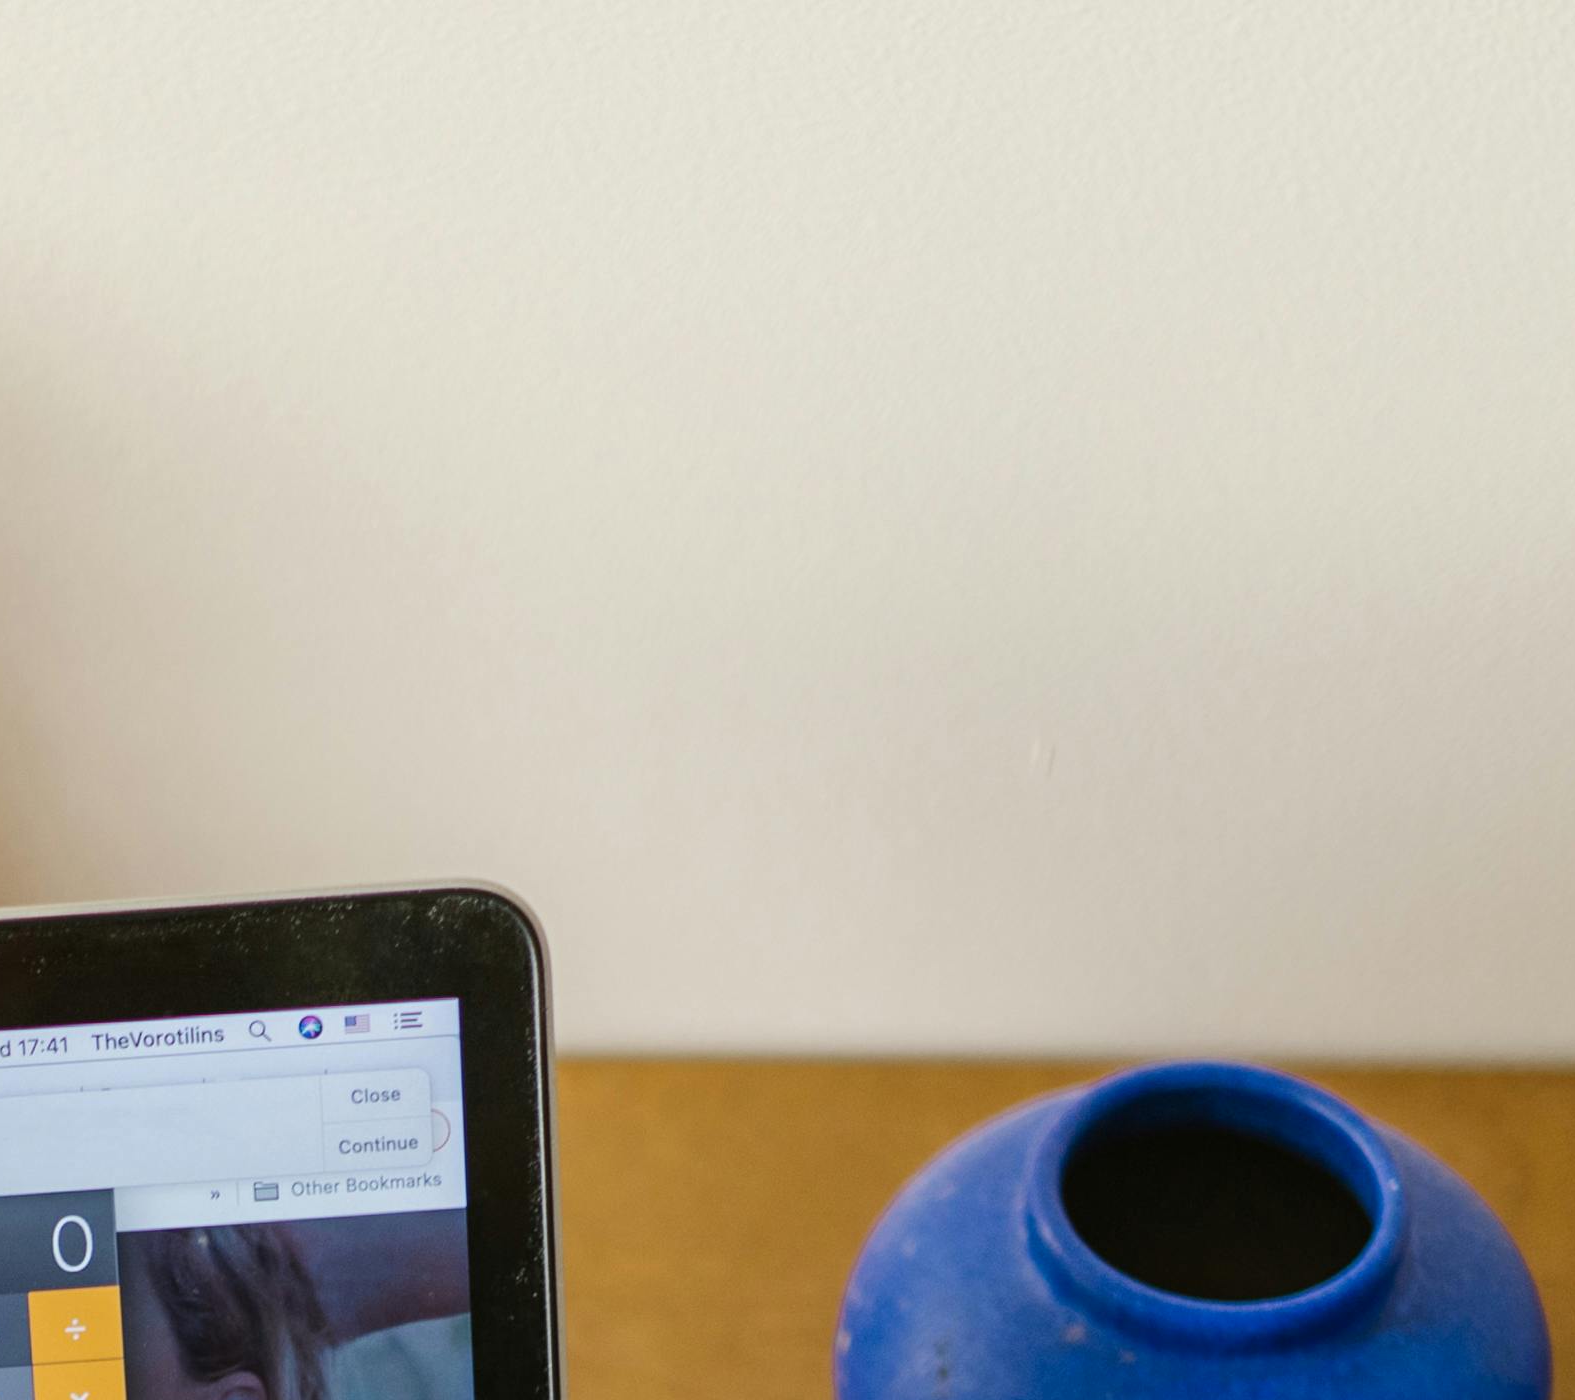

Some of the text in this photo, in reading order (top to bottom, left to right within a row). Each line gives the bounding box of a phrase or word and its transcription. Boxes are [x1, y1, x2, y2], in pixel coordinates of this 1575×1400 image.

[18, 1036, 68, 1056] 17:41
[91, 1026, 225, 1051] TheVorotilins
[350, 1088, 401, 1105] Close
[338, 1137, 419, 1155] Continue
[290, 1172, 443, 1197] Other Bookmarks
[52, 1214, 93, 1273] 0
